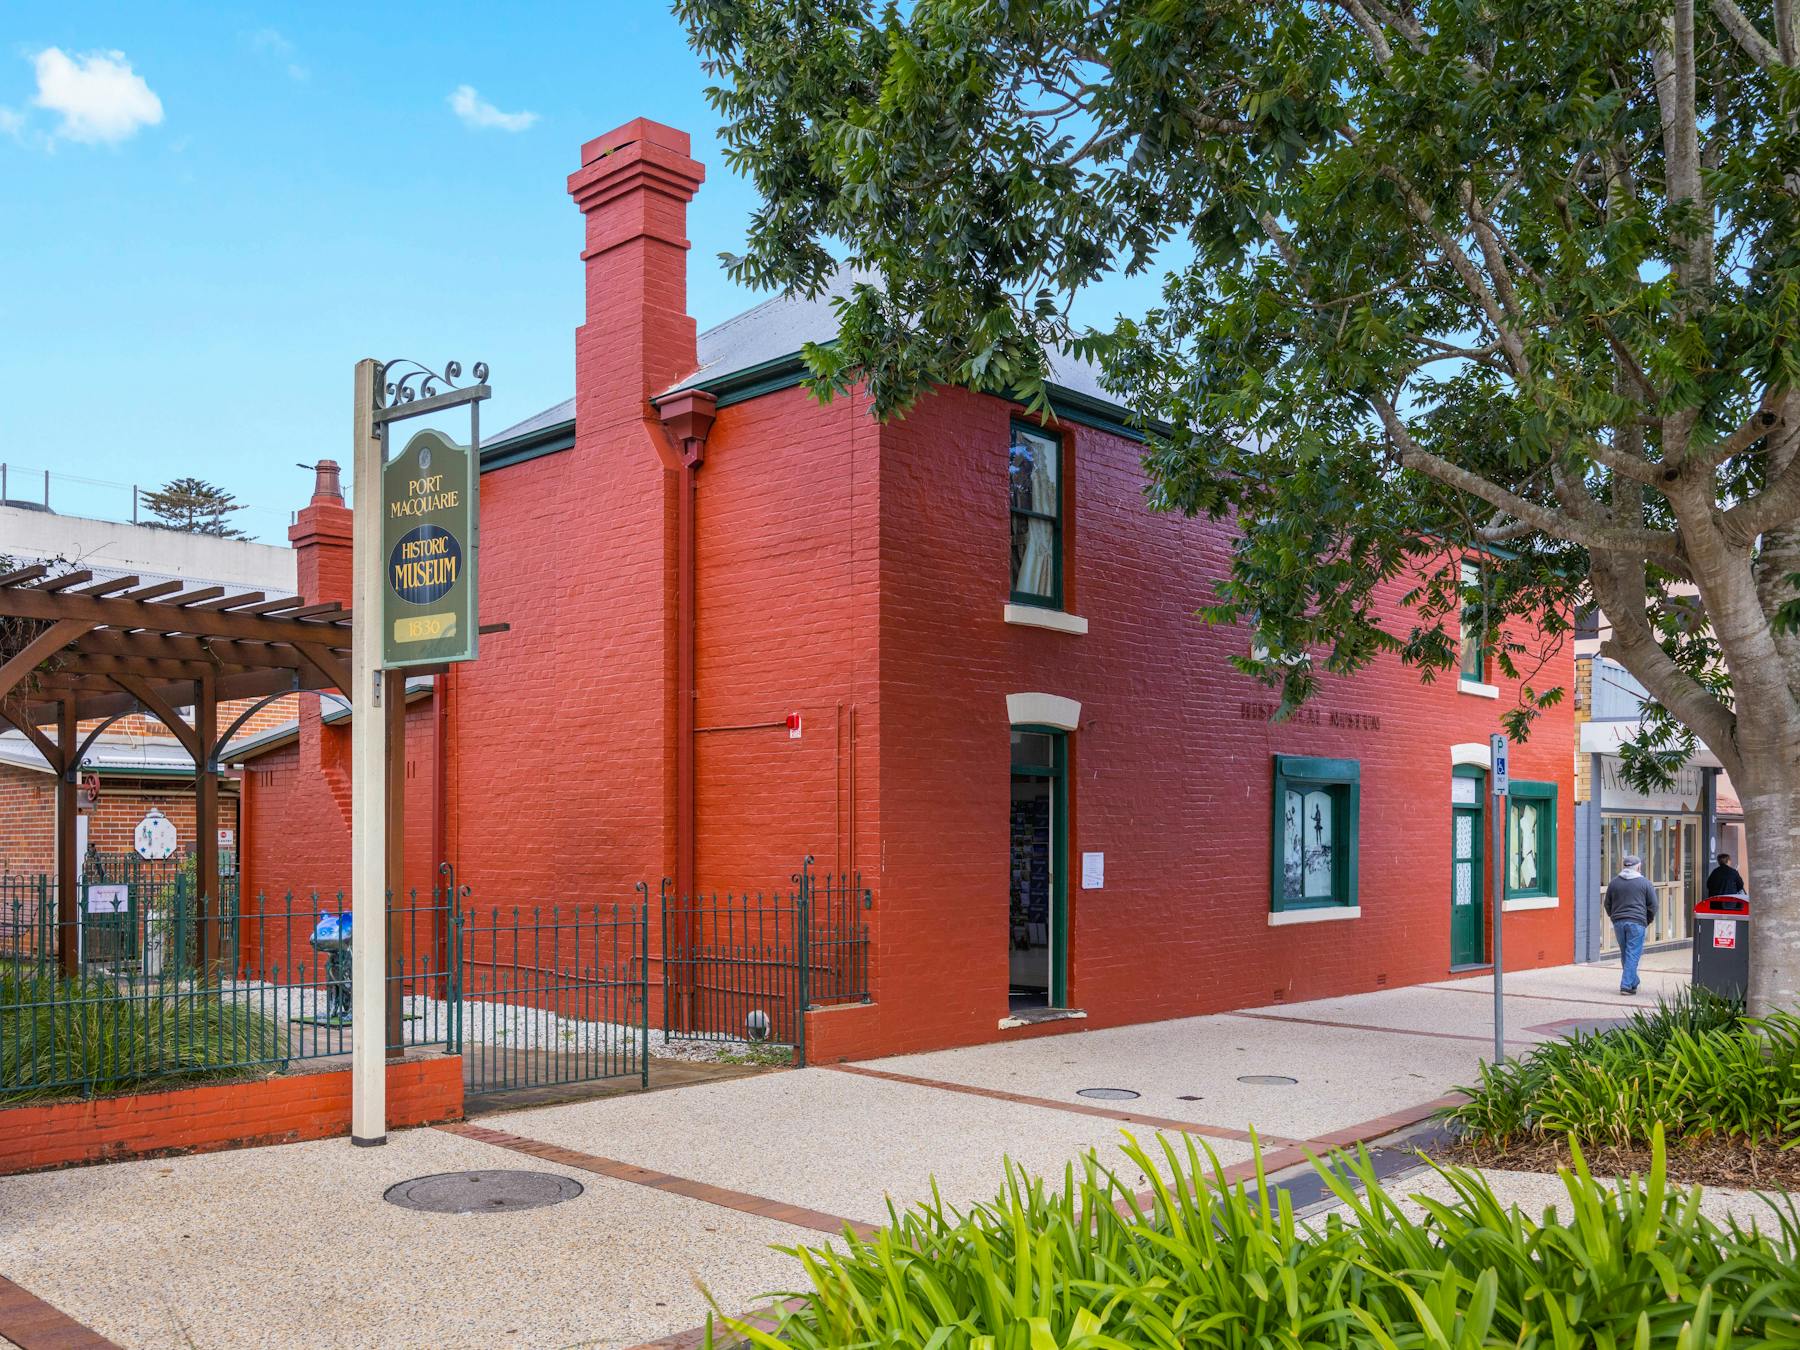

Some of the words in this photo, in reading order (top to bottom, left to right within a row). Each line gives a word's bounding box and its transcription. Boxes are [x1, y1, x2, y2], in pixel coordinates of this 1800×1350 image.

[408, 475, 443, 497] PORT
[391, 491, 459, 518] MACQUARIE
[402, 536, 449, 560] HISTORIC
[395, 555, 456, 590] MUSEUM
[408, 620, 441, 637] 1830
